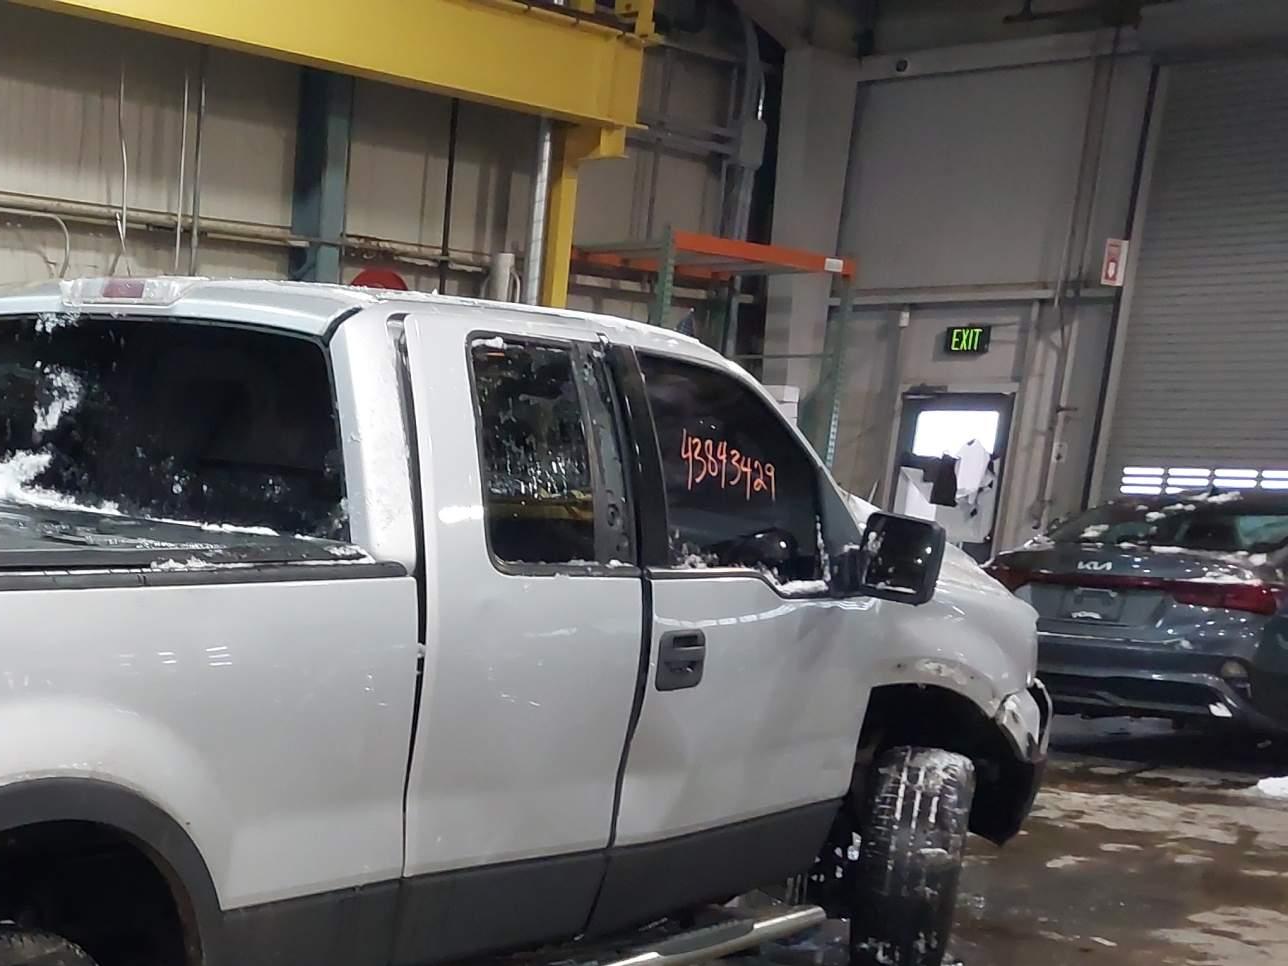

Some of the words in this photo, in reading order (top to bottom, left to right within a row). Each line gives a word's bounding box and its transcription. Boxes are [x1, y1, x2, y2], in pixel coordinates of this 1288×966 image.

[951, 328, 983, 351] EXIT
[680, 428, 776, 501] 43843429
[1077, 561, 1113, 571] KIA
